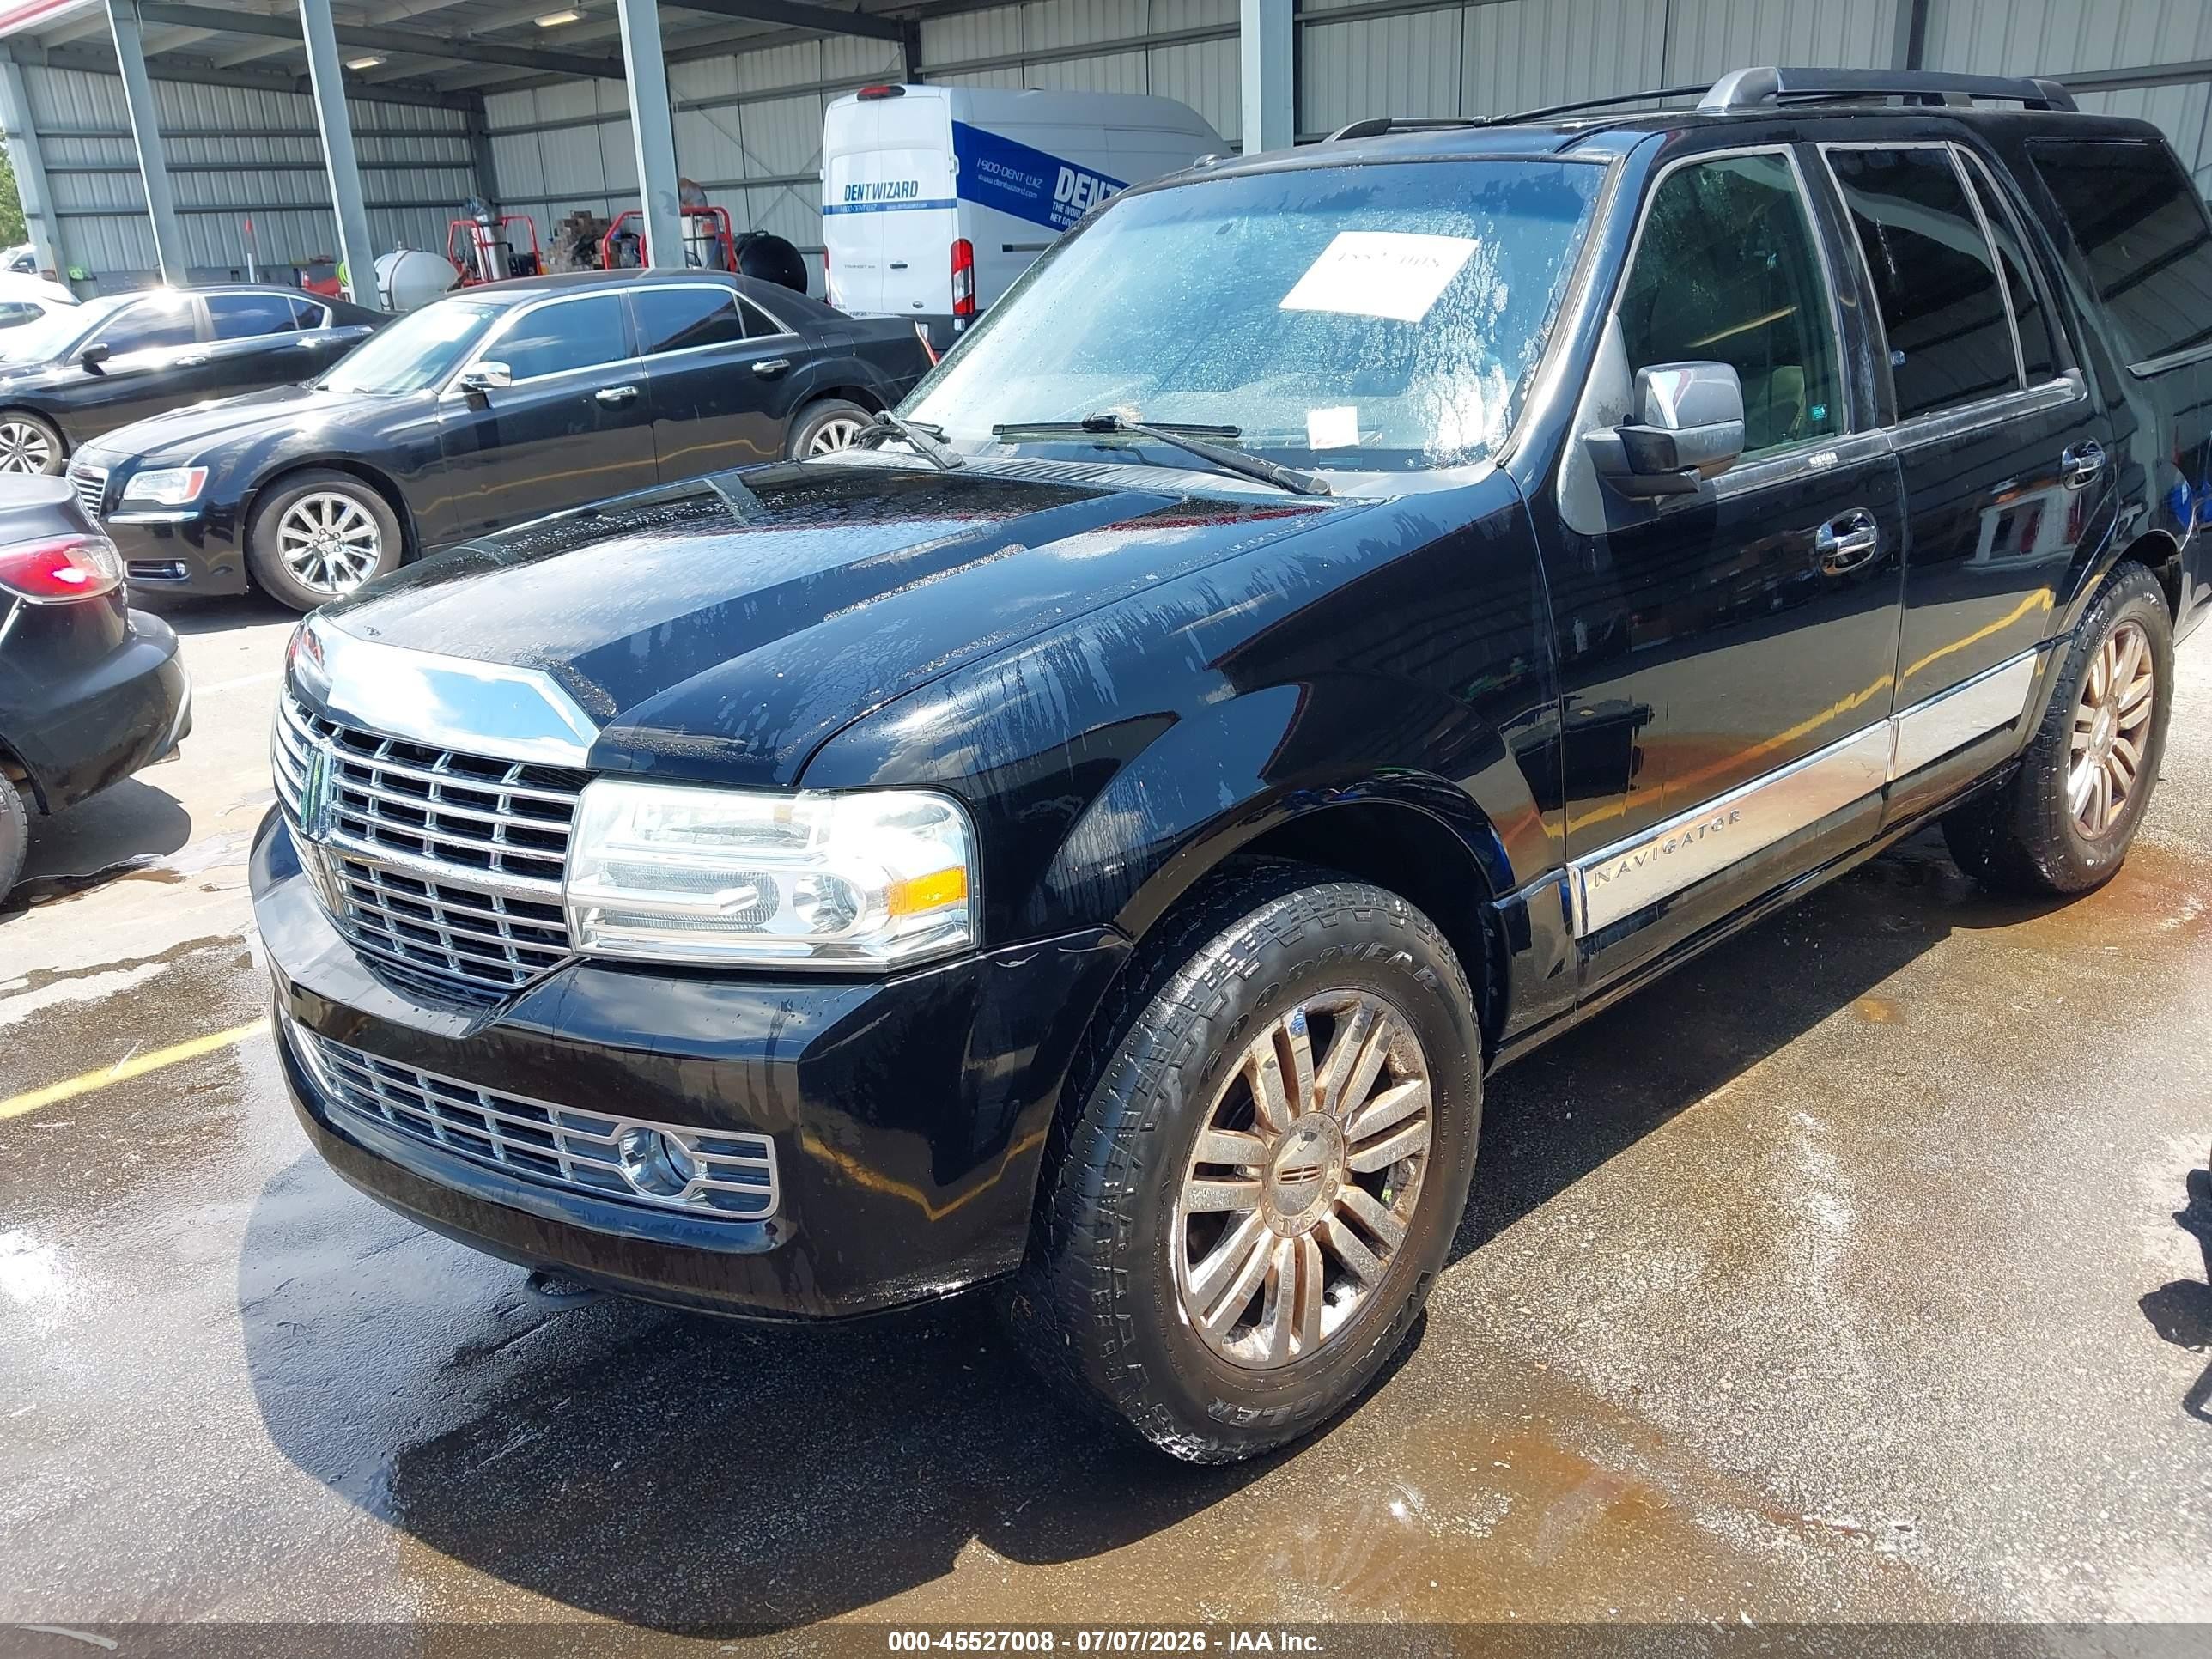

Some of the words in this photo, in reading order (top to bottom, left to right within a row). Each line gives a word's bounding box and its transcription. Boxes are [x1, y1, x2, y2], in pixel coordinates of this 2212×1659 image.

[844, 183, 872, 202] DENT
[872, 179, 920, 200] WIZARD
[1052, 200, 1066, 214] THE
[1595, 809, 1741, 888] NAVIGATOR
[1199, 941, 1439, 1080] GOODYEAR
